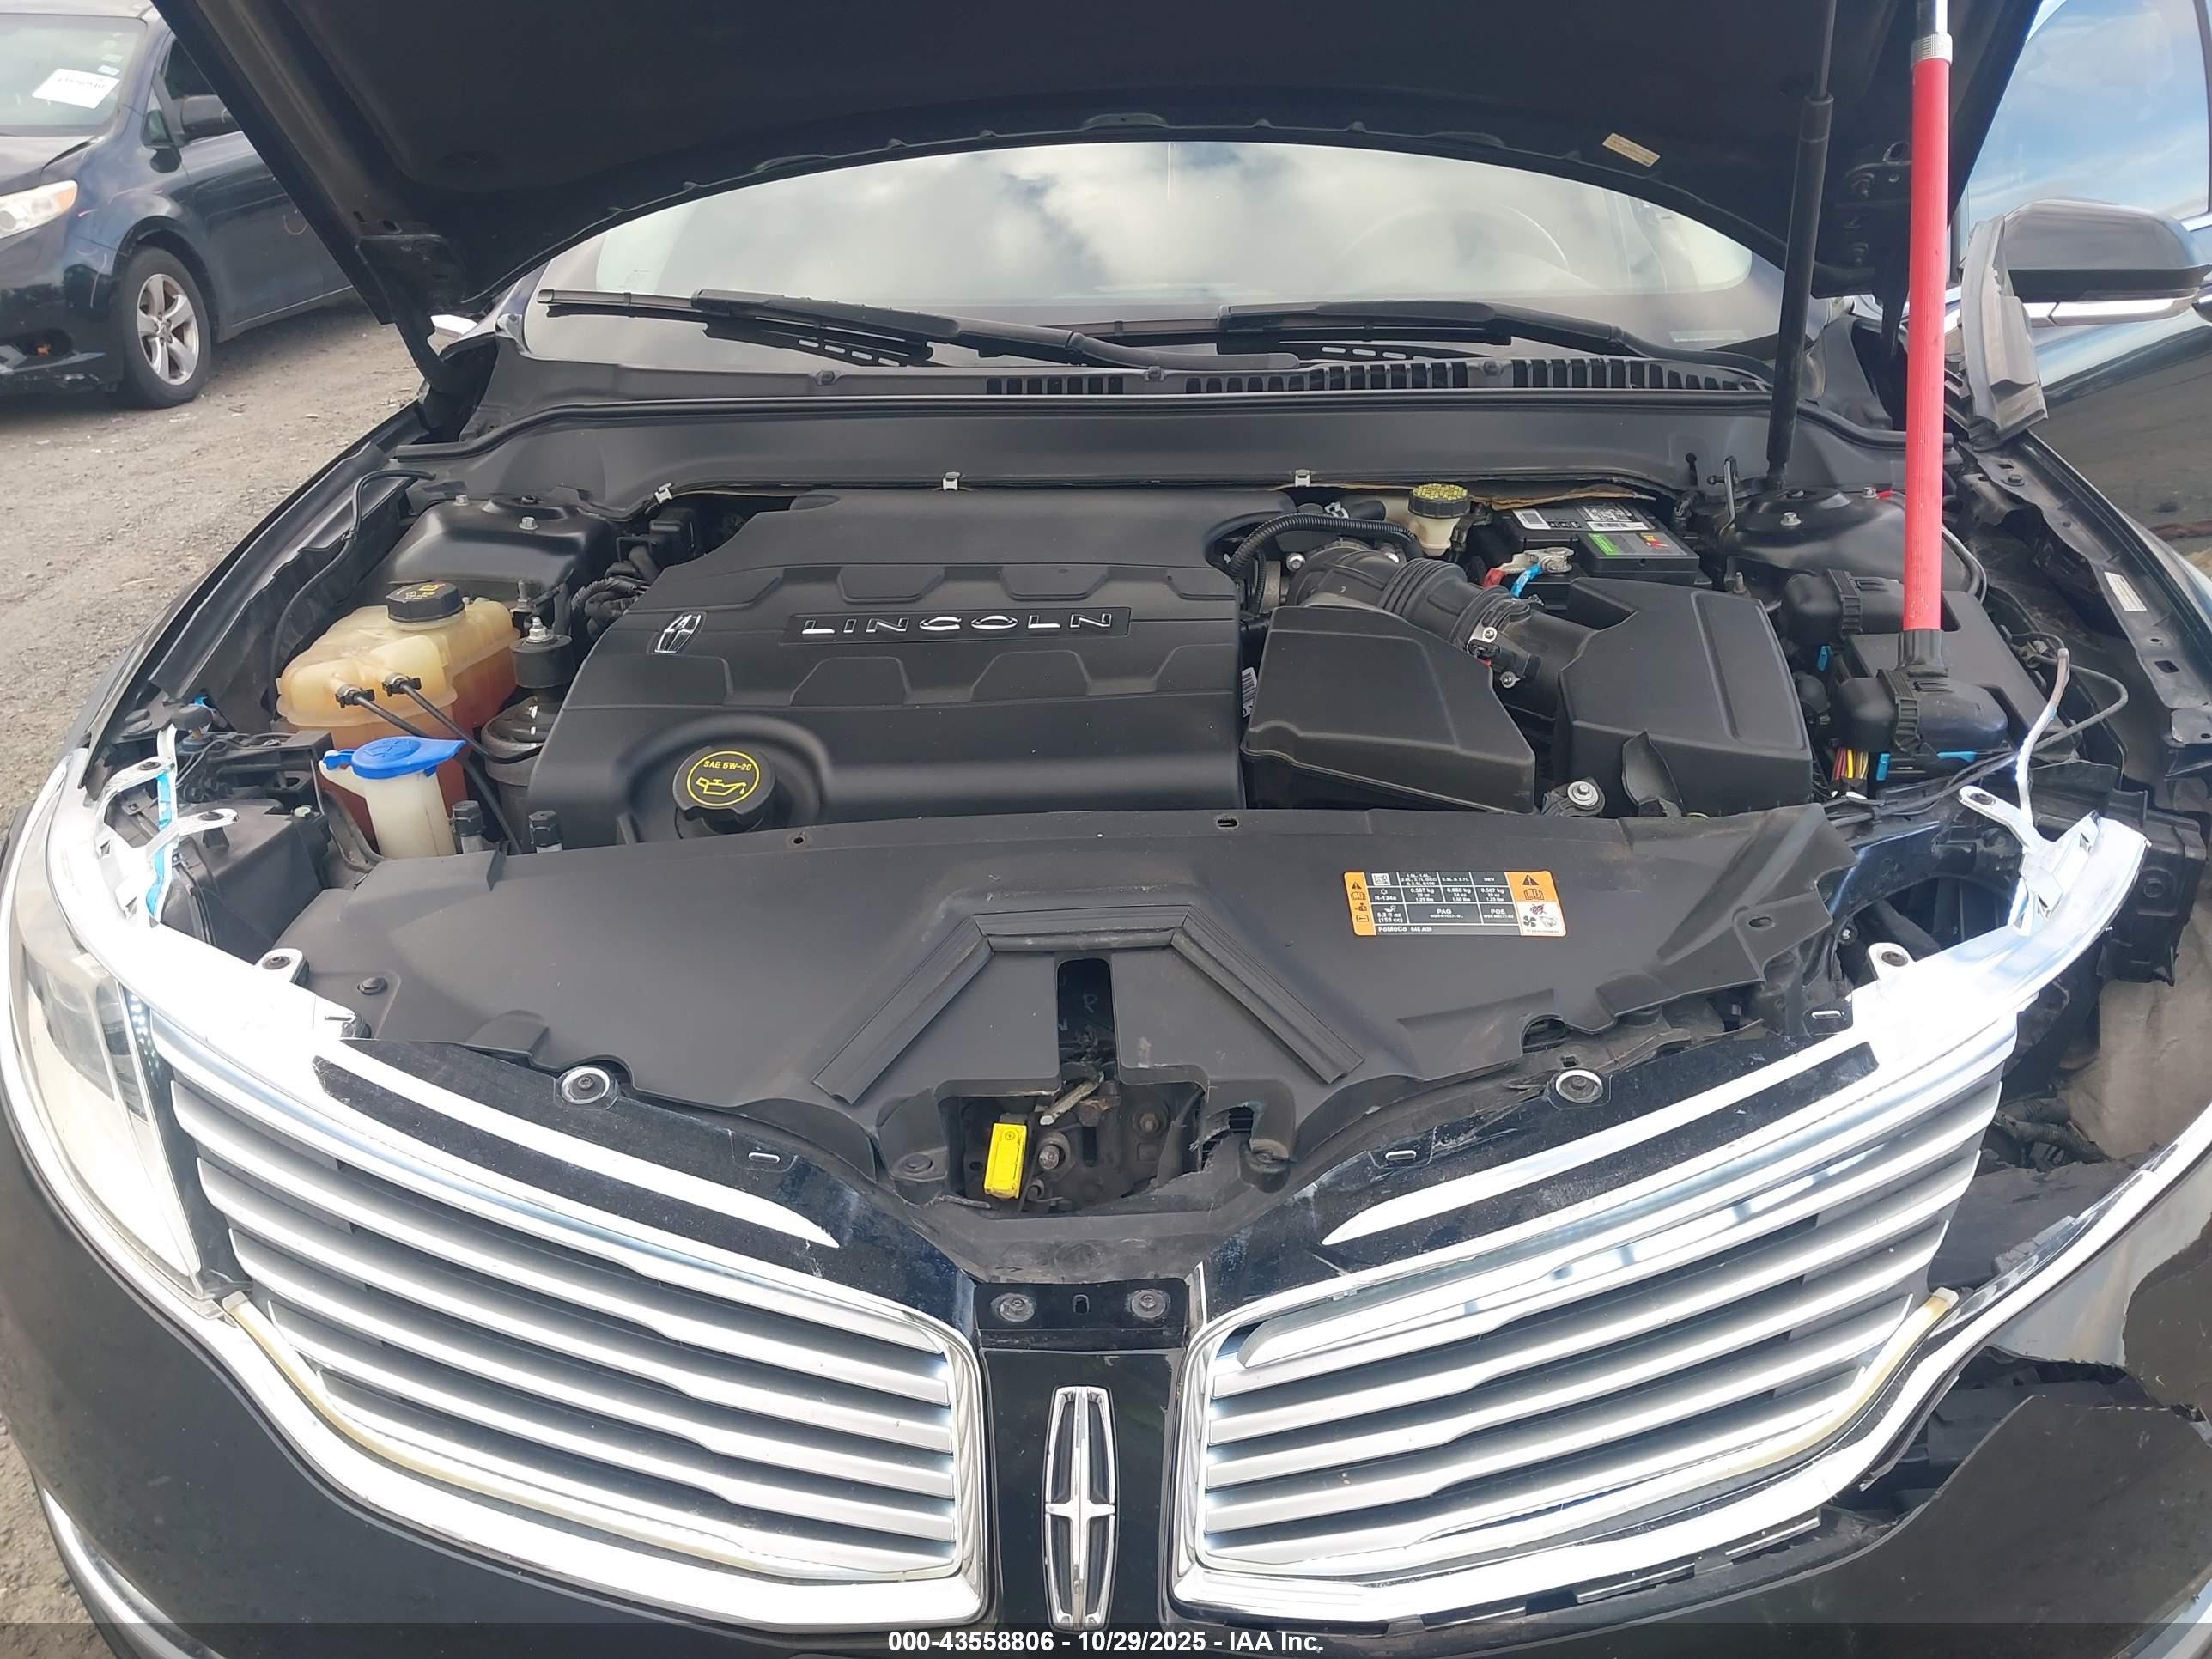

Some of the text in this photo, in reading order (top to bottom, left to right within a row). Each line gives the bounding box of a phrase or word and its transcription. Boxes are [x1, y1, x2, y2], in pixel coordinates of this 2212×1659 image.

[801, 613, 1113, 635] LINCOLN
[703, 760, 752, 771] SAE 5W-20
